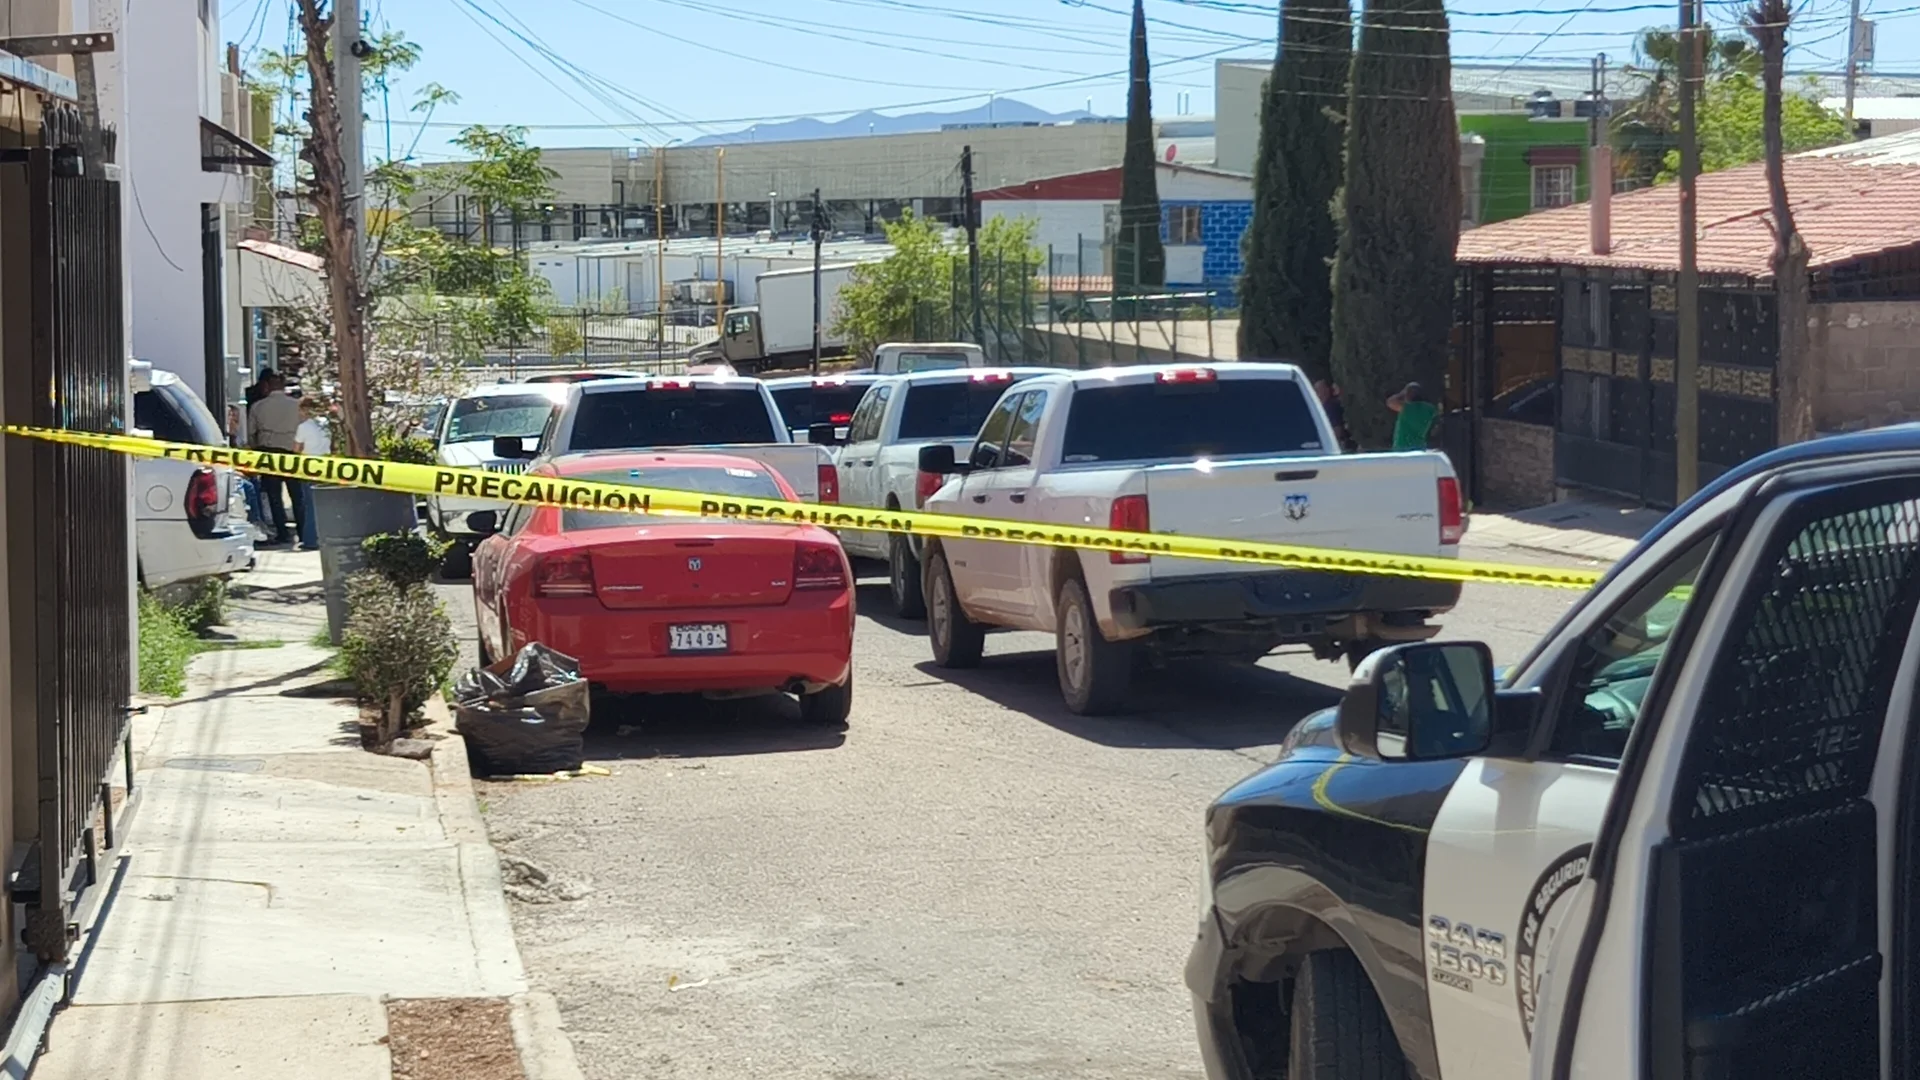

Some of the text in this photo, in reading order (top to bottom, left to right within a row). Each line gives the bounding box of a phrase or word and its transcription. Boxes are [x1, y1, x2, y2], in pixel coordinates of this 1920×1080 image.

[434, 471, 651, 512] PRECAUCIÓN
[1428, 914, 1507, 959] RAM
[1523, 912, 1539, 948] DE
[1430, 941, 1507, 986] 1500
